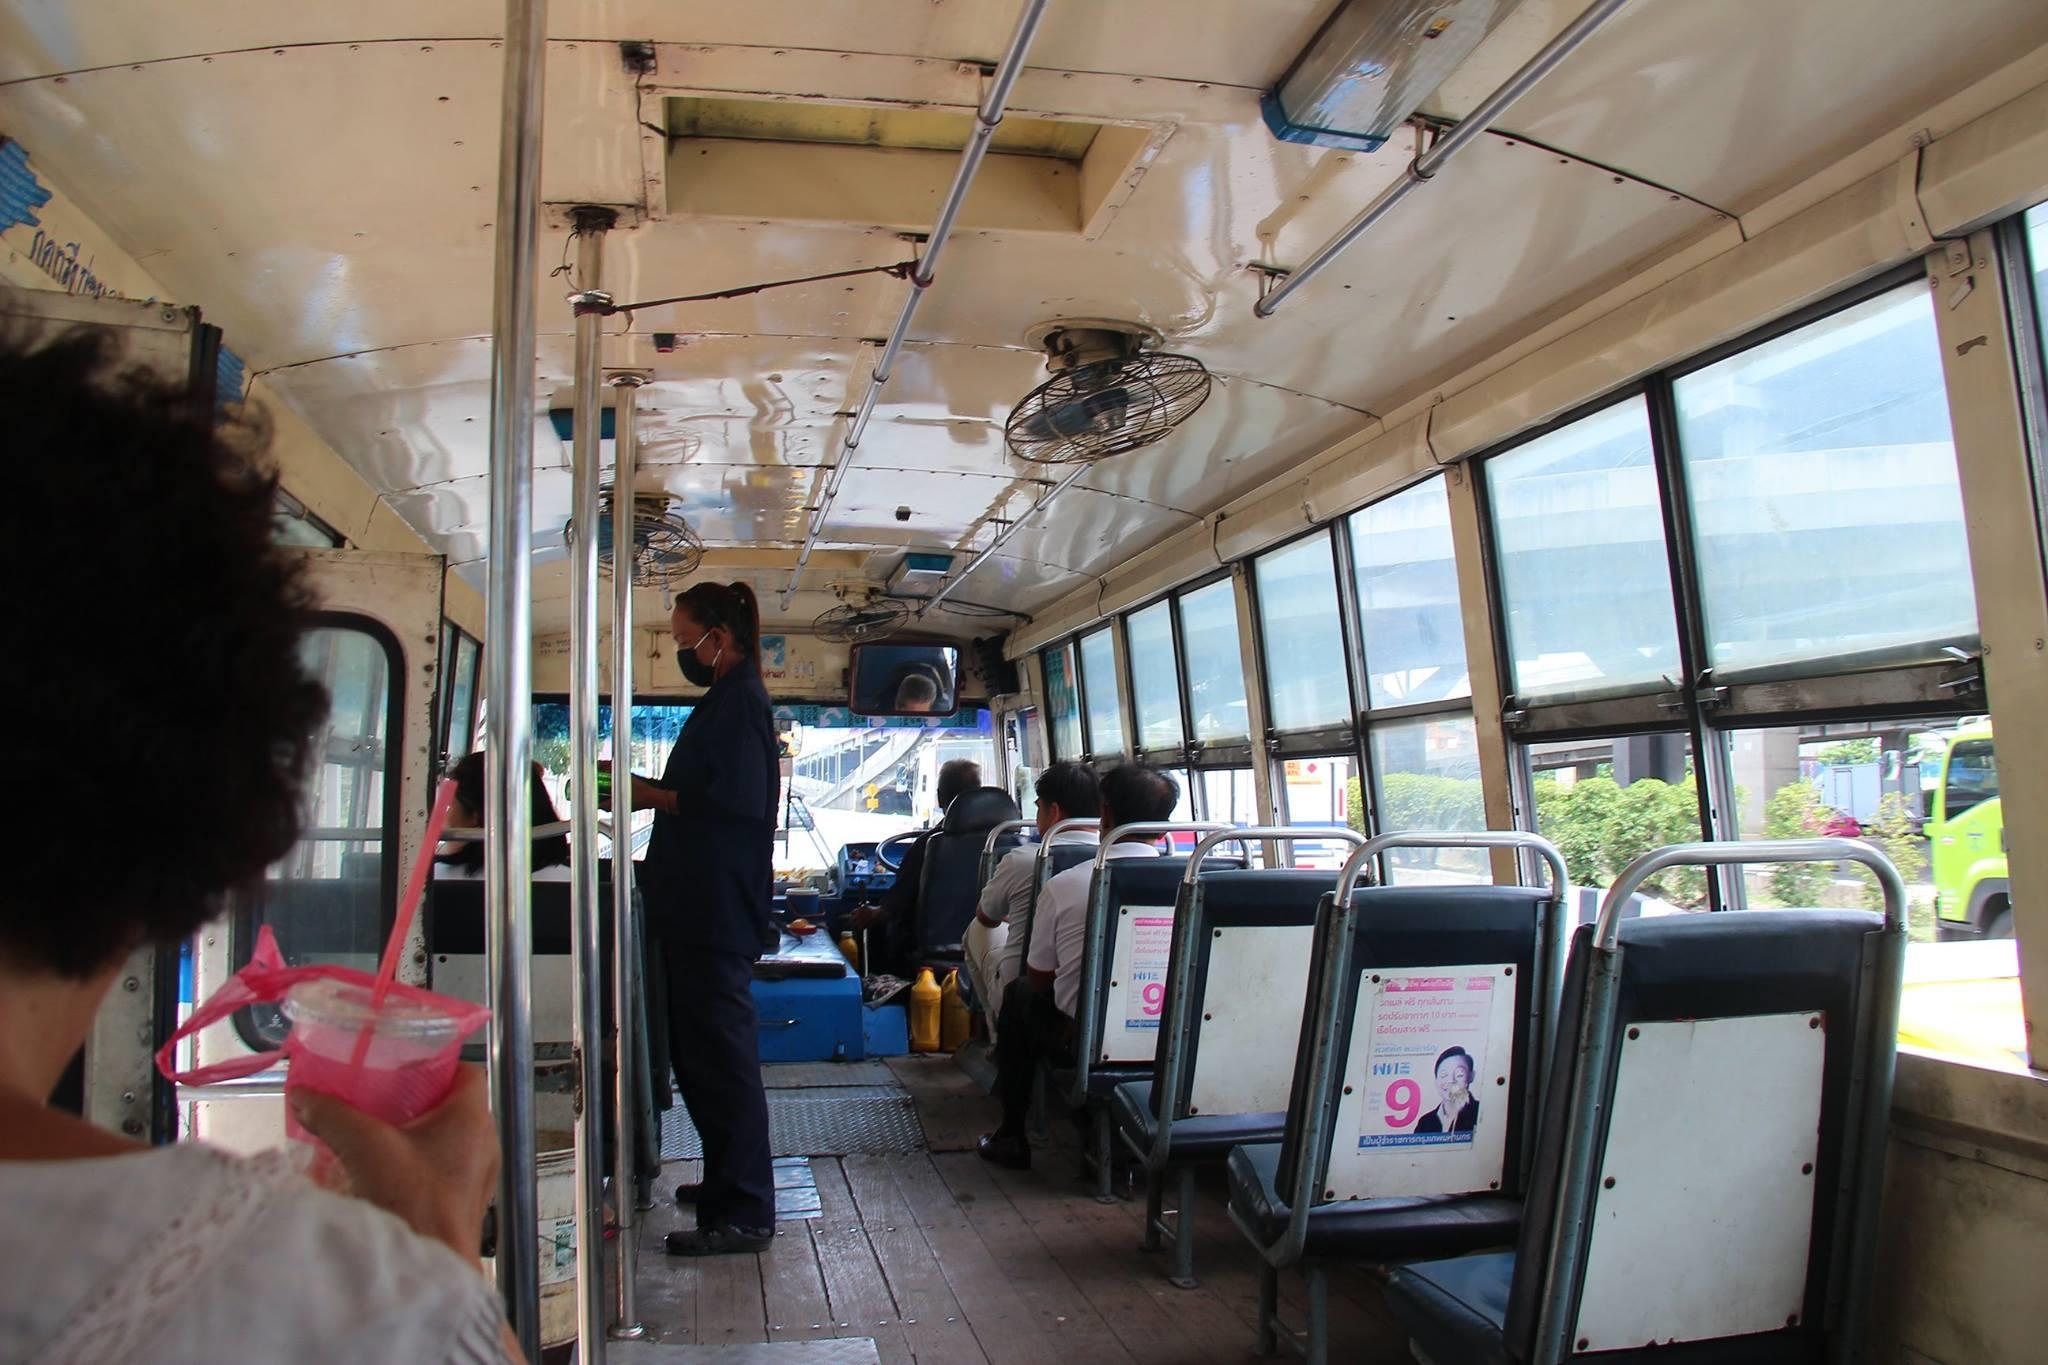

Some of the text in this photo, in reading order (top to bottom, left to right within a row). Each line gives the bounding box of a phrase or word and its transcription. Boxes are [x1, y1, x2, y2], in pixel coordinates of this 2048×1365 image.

[1142, 982, 1165, 1016] 9
[1431, 1010, 1441, 1019] 10
[1384, 1078, 1422, 1128] 9
